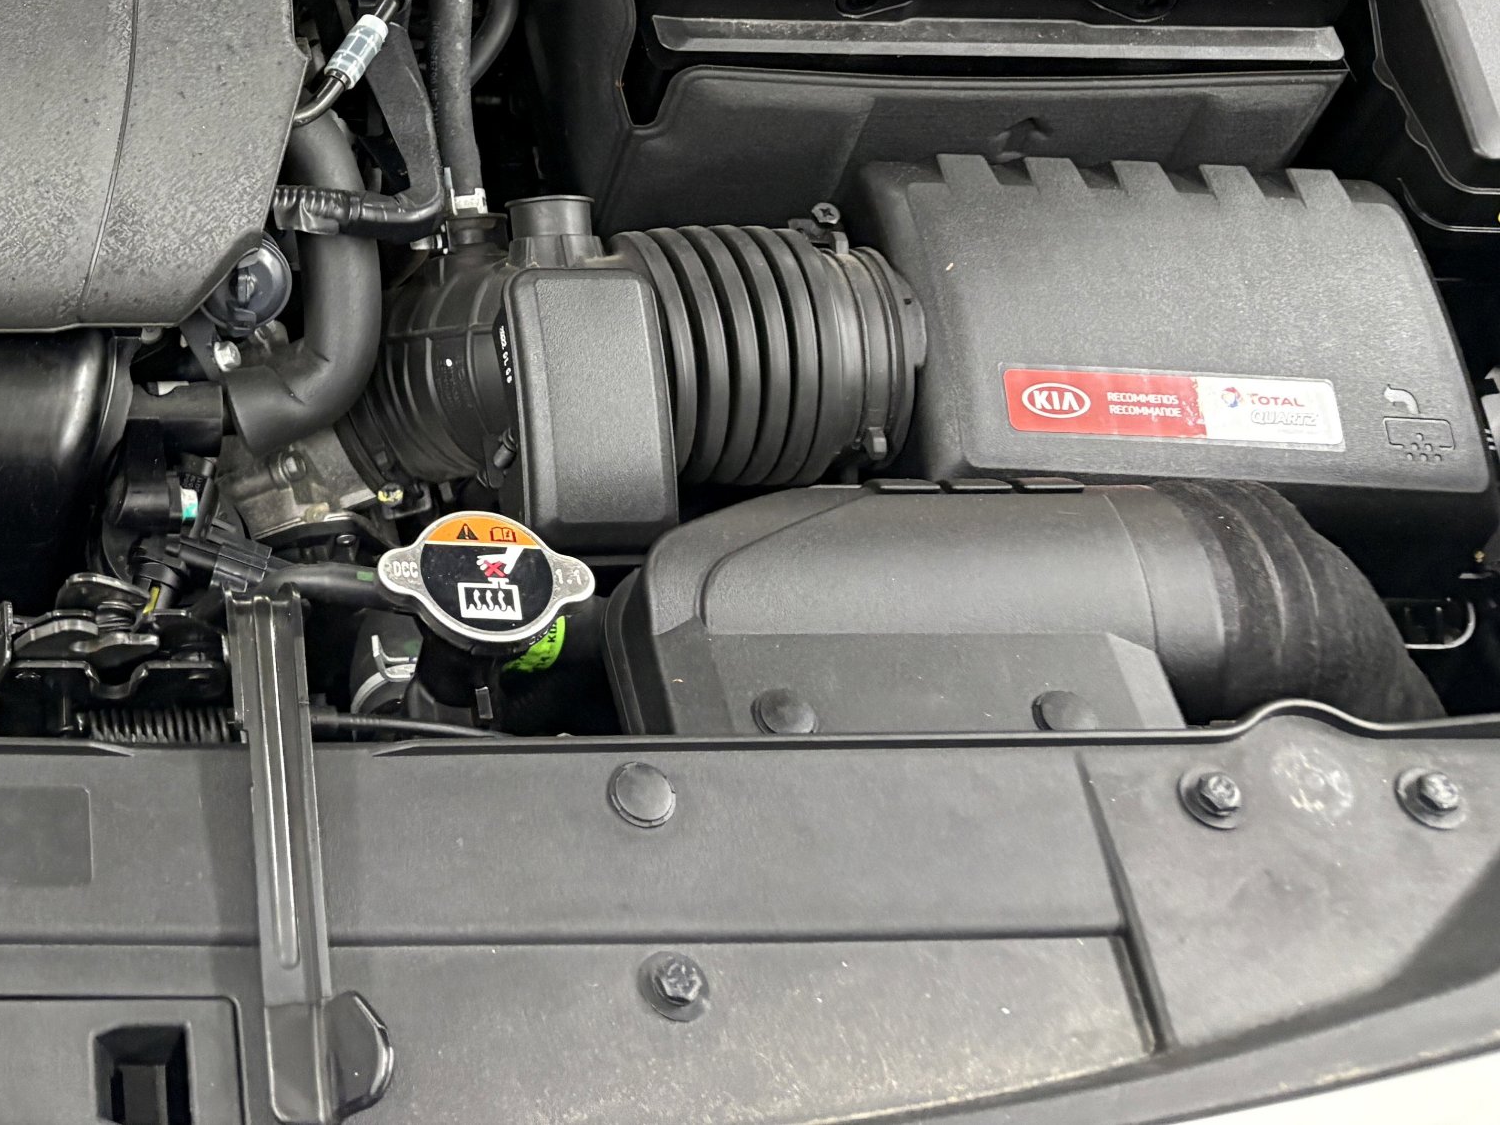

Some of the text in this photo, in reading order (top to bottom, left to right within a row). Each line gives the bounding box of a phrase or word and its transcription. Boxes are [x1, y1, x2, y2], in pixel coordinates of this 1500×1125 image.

[1033, 390, 1305, 411] KIA RECOMMENDS TOTAL
[1108, 404, 1319, 427] RECOMMANDE QUARTZ
[392, 560, 419, 577] DCC
